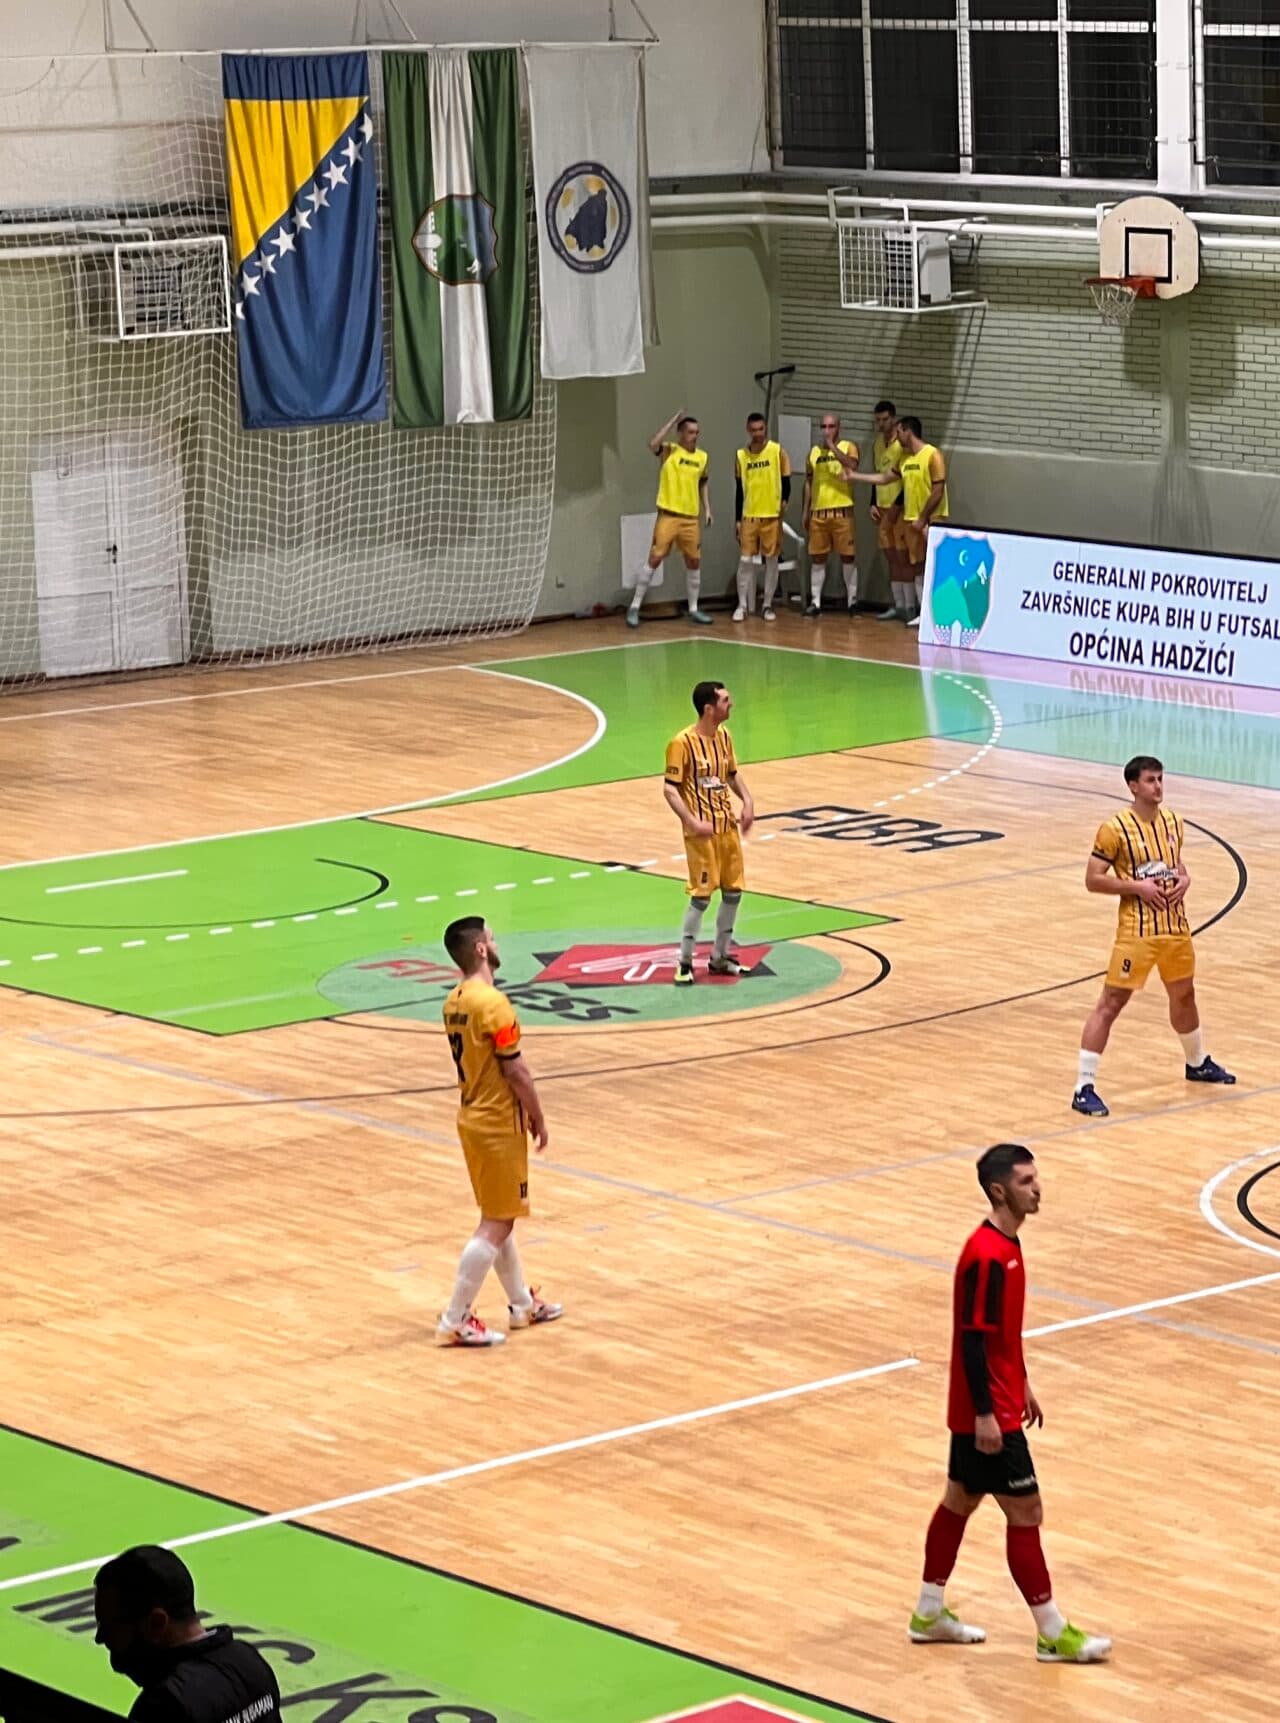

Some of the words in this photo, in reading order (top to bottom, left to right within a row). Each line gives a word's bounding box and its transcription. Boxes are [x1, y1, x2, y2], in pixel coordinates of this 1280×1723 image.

[1053, 561, 1147, 591] GENERALNI
[1150, 571, 1268, 604] POKROVITELJ
[1020, 589, 1112, 620] ZAVRŠNICE
[1116, 600, 1160, 627] KUPA
[1165, 606, 1196, 632] BIH
[1200, 610, 1212, 632] U
[1069, 627, 1144, 666] OPĆINA
[1150, 639, 1235, 678] HADŽIĆI
[754, 805, 1006, 853] FIBA
